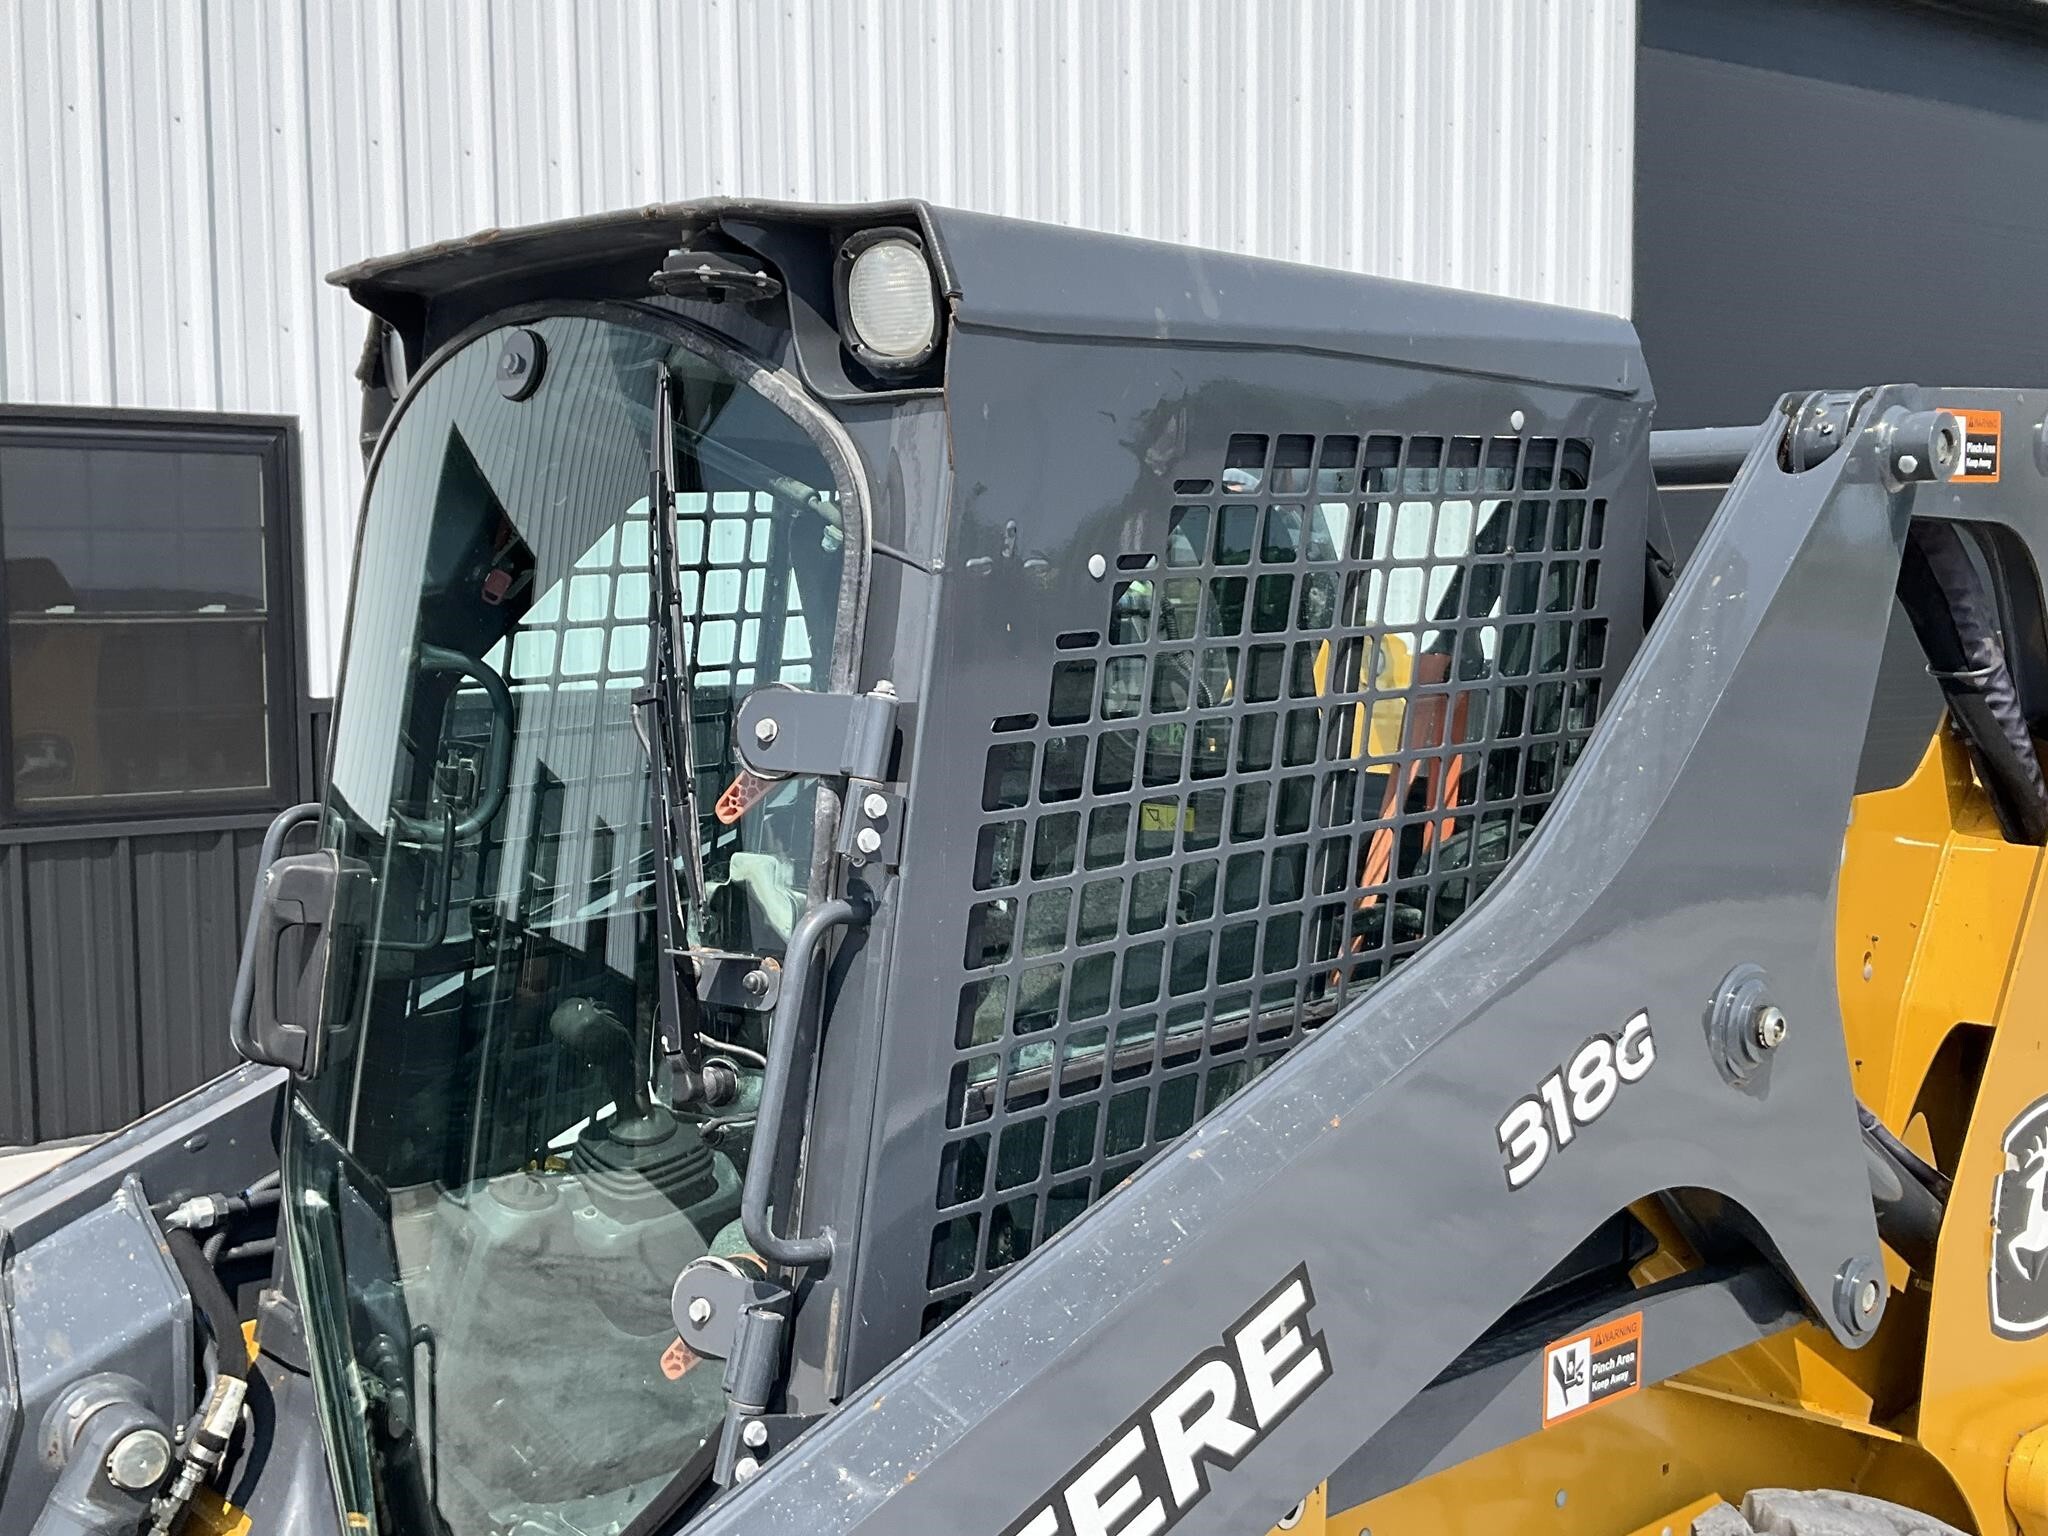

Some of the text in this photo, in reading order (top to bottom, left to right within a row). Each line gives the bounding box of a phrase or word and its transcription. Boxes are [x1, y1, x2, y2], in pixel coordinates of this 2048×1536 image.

[1496, 1009, 1657, 1189] 318G
[1602, 1322, 1638, 1342] WARNING
[1592, 1352, 1635, 1376] Pinch Area
[1591, 1370, 1629, 1392] Keep Away
[1010, 1273, 1327, 1536] ERE
